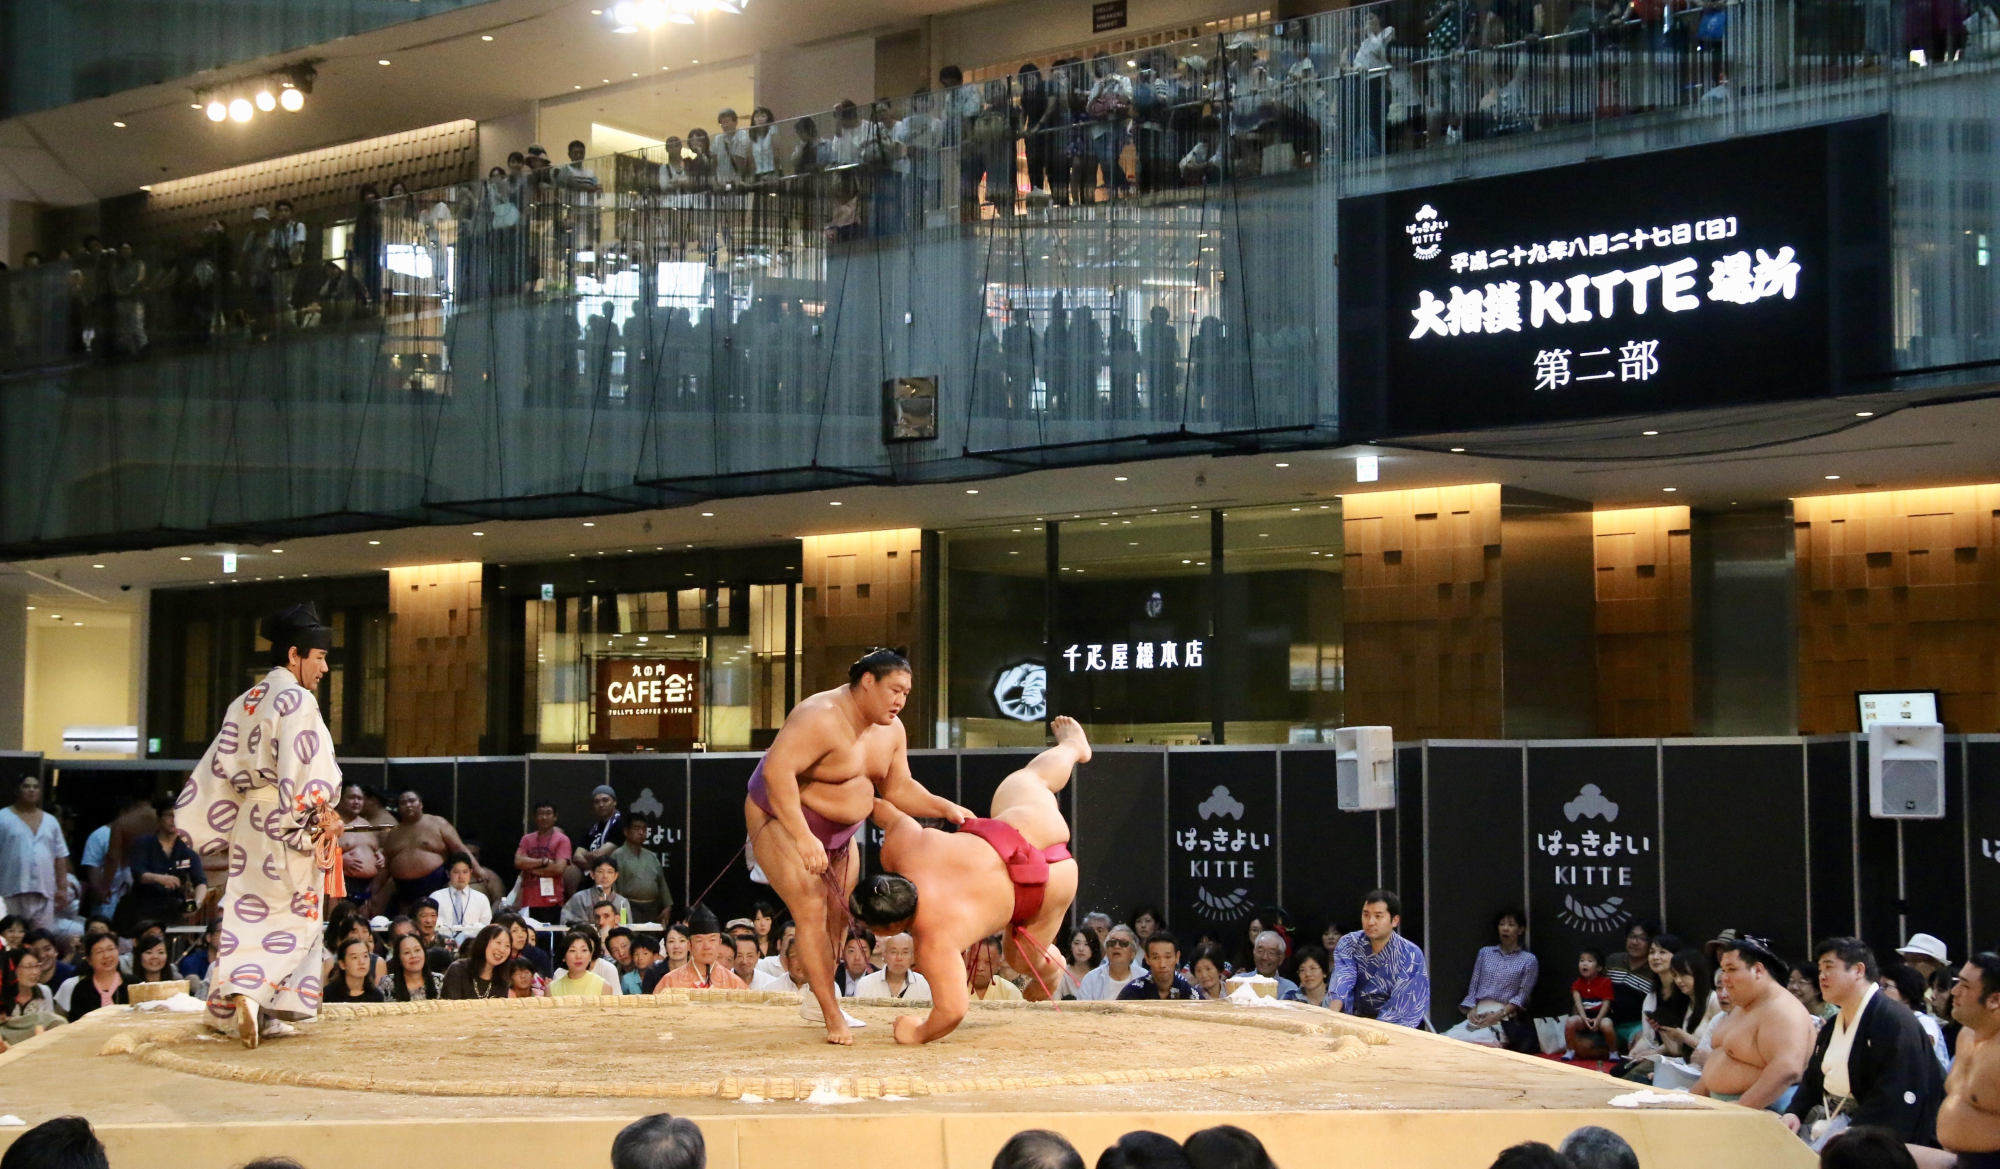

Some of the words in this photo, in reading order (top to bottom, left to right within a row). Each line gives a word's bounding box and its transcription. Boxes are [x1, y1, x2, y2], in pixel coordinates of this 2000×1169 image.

[1412, 233, 1442, 245] KITTE
[1409, 280, 1522, 339] 大相撲
[1530, 257, 1699, 328] KITTE
[1707, 246, 1801, 304] 場所
[1534, 340, 1659, 390] 第二部
[632, 663, 666, 677] 丸の内
[635, 707, 661, 715] COFFEE
[1190, 860, 1255, 878] KITTE
[1554, 865, 1632, 886] KITTE
